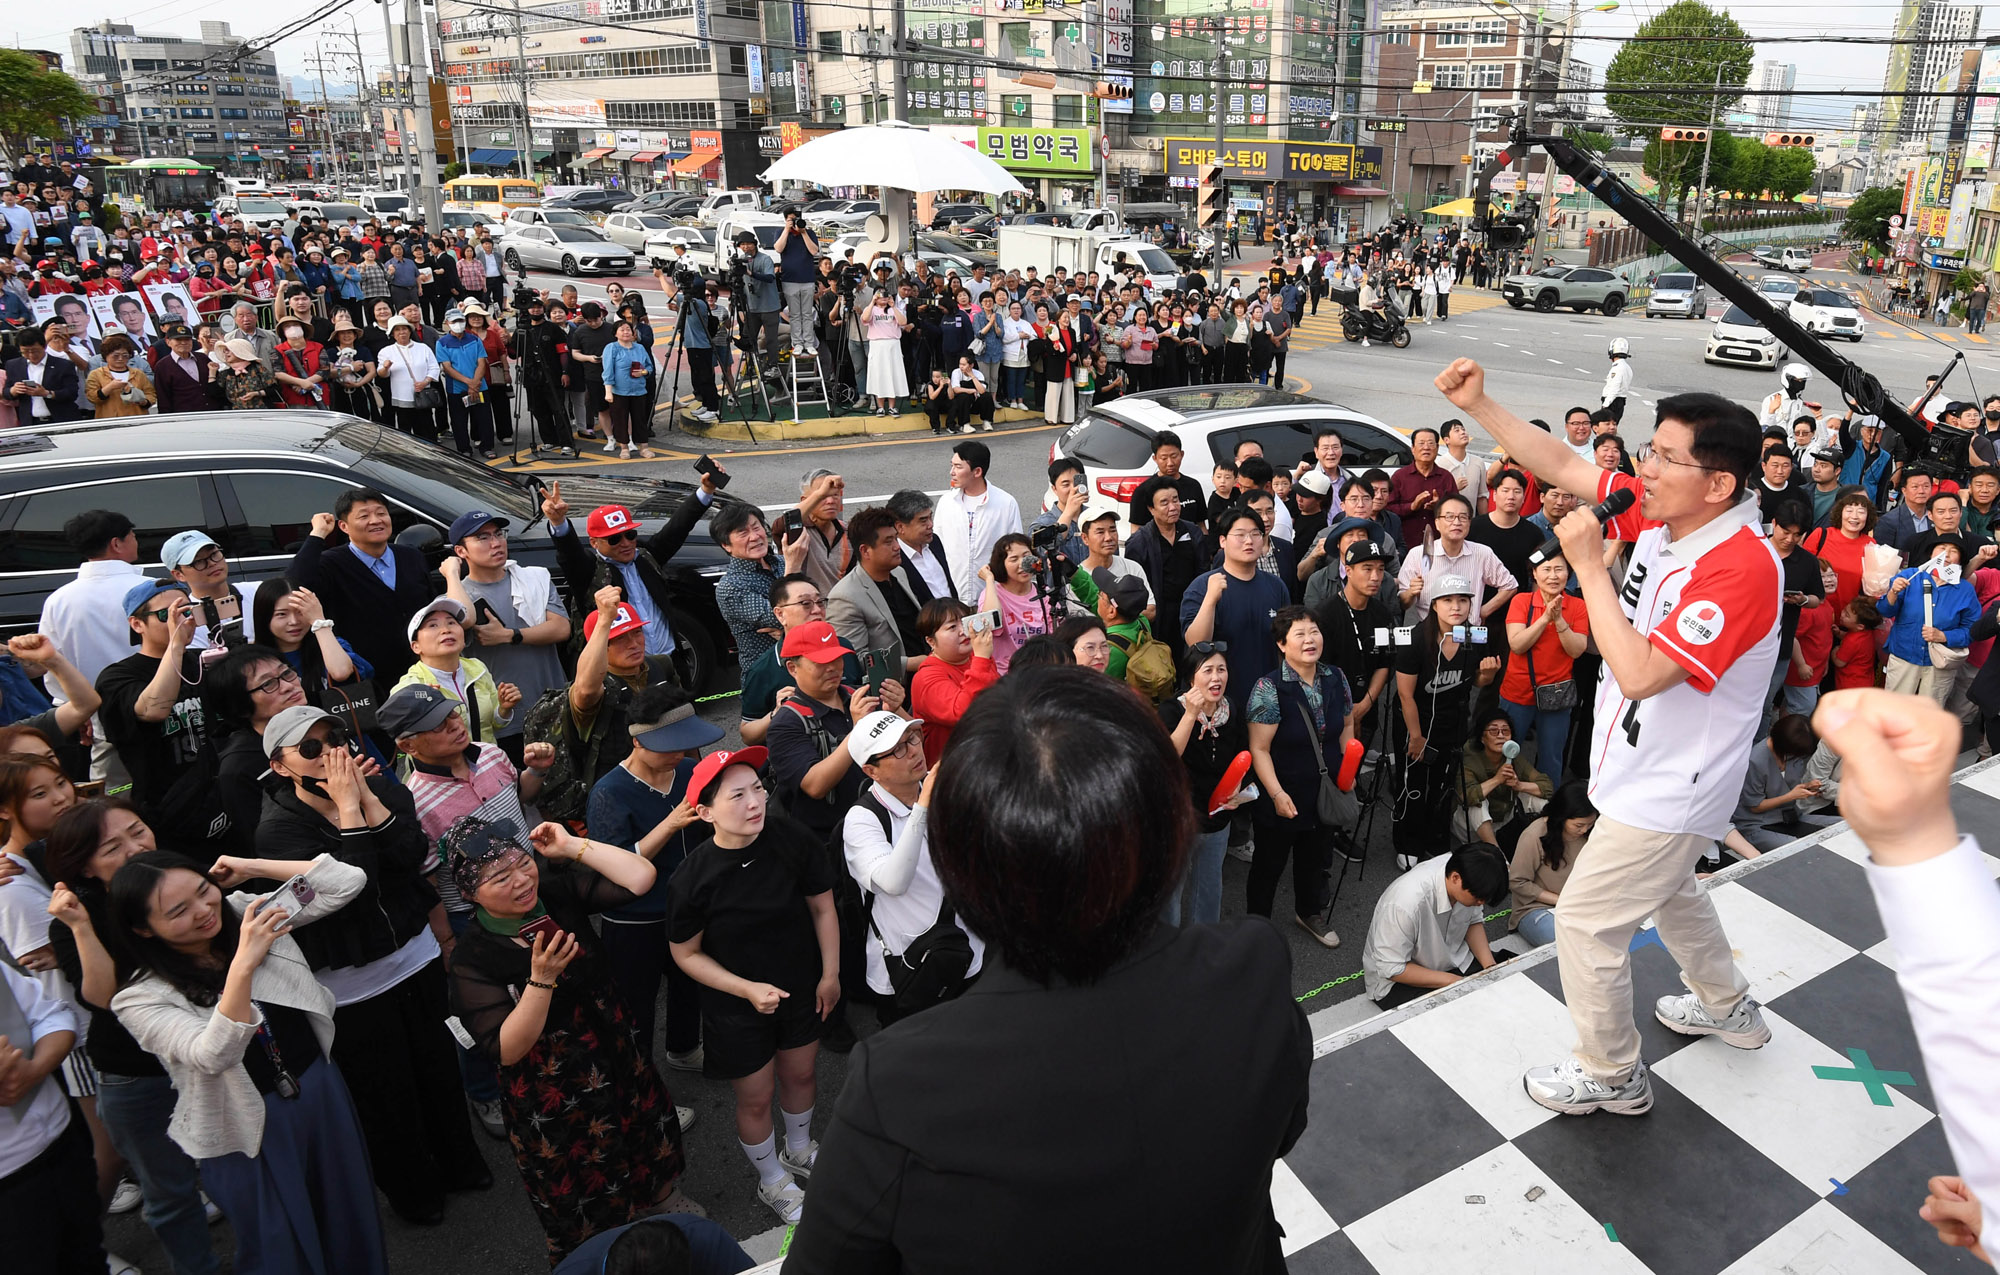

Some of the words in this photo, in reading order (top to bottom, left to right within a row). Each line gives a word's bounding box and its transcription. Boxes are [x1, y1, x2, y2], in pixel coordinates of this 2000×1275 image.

[987, 134, 1079, 164] 모범약국
[1178, 149, 1268, 168] 모바일스토어
[1440, 579, 1467, 589] Kings
[1682, 615, 1712, 640] 국민의힘
[1433, 669, 1463, 686] RUN
[331, 697, 371, 714] CELINE
